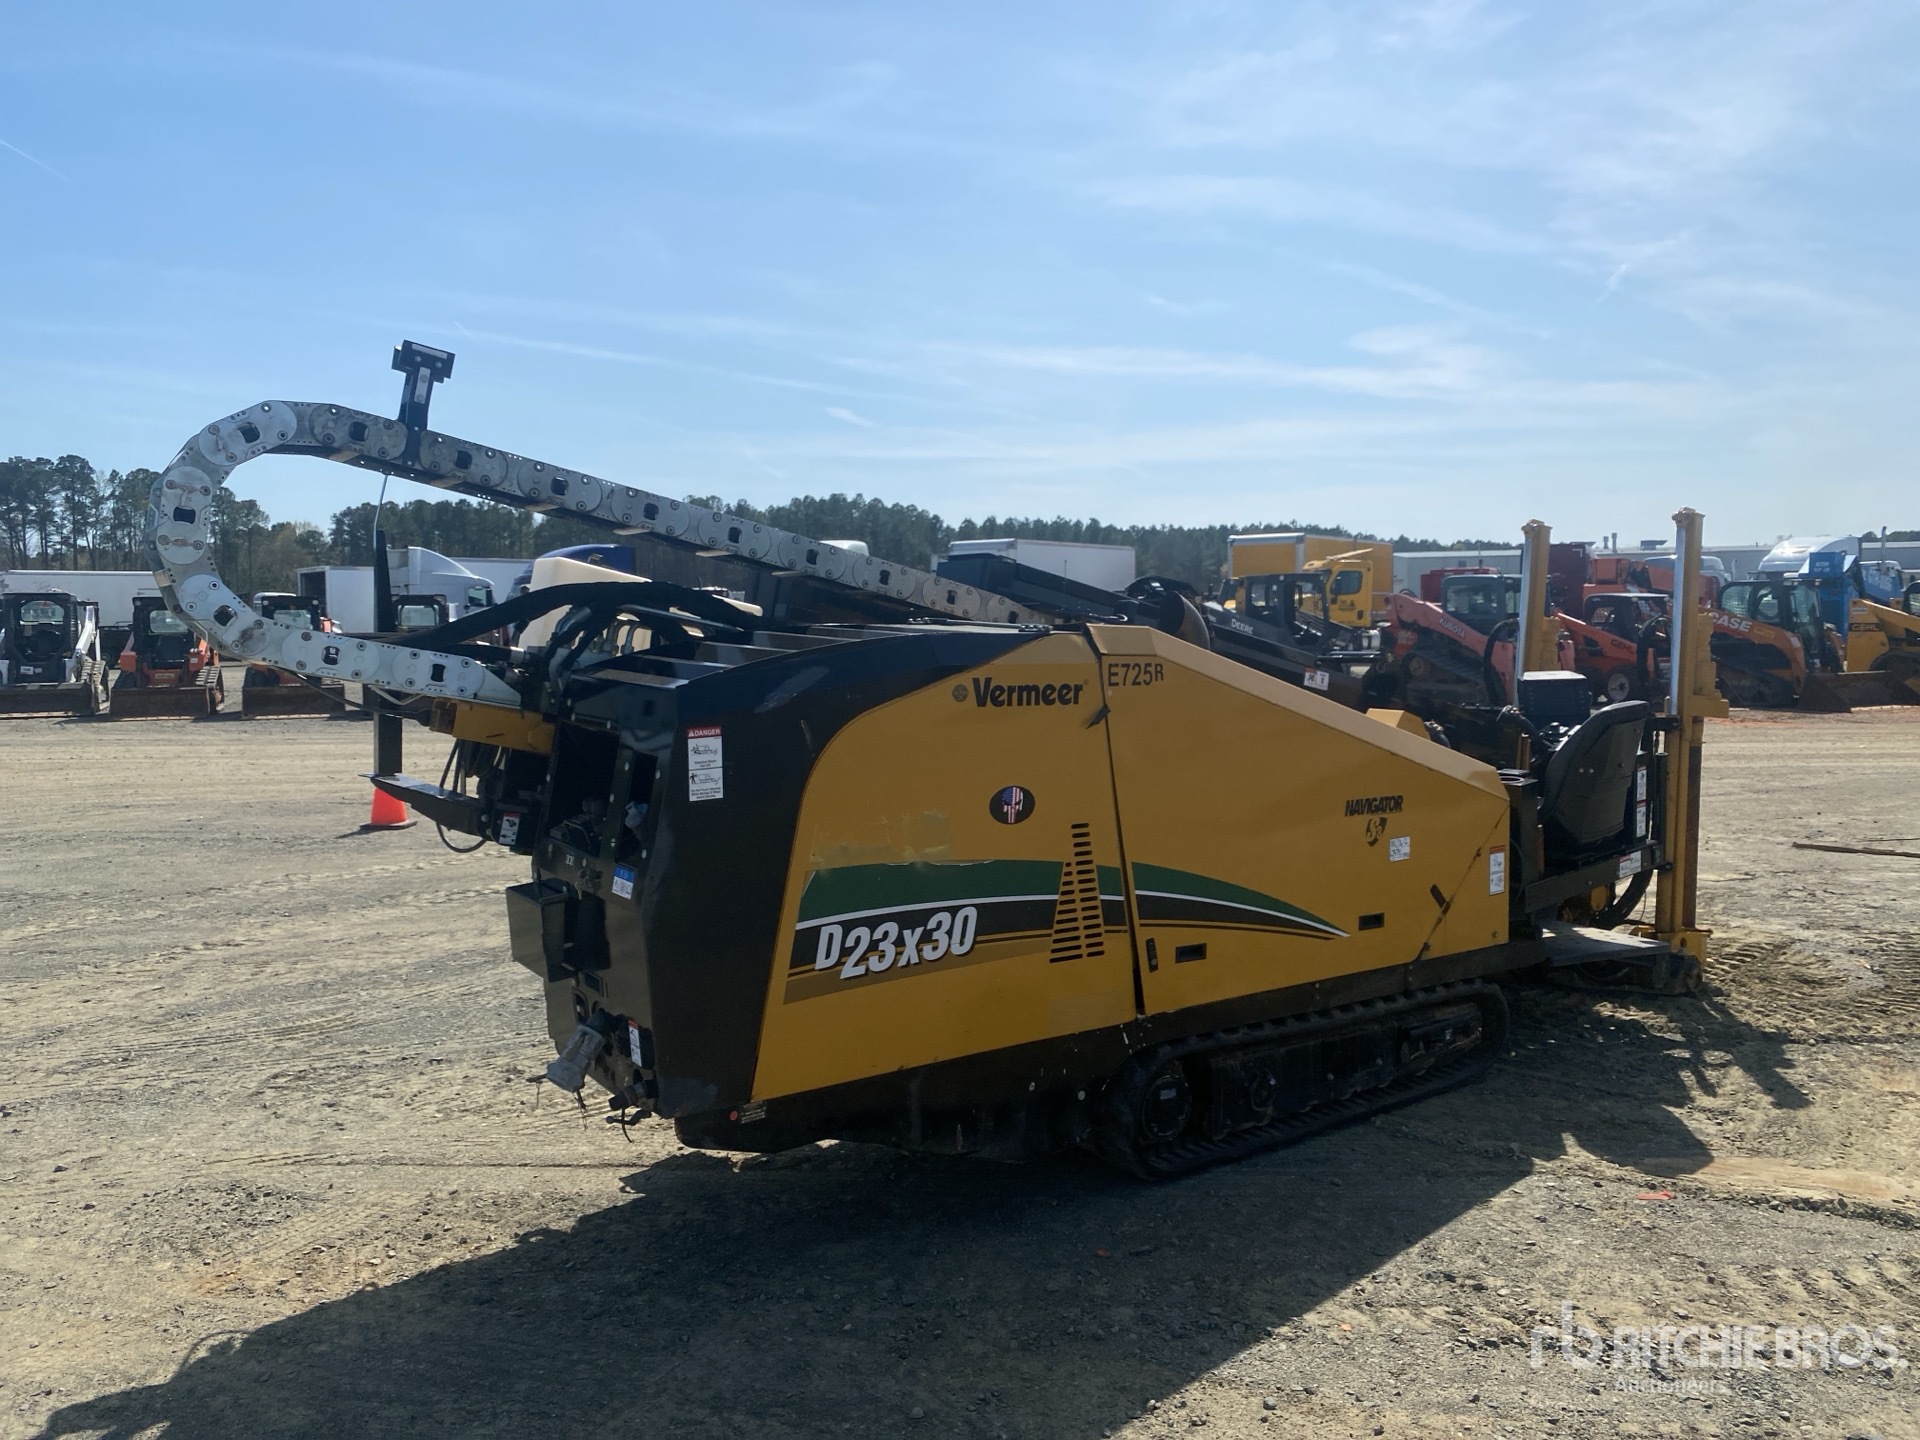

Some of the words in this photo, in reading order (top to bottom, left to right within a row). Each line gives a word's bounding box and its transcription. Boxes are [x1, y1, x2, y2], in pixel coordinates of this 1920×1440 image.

[1231, 618, 1254, 635] DEERE
[1439, 617, 1466, 638] KUBOTA
[1108, 663, 1164, 687] E725R
[972, 677, 1084, 708] Vermeer
[694, 728, 720, 736] DANGER
[1344, 795, 1404, 817] NAVIGATOR
